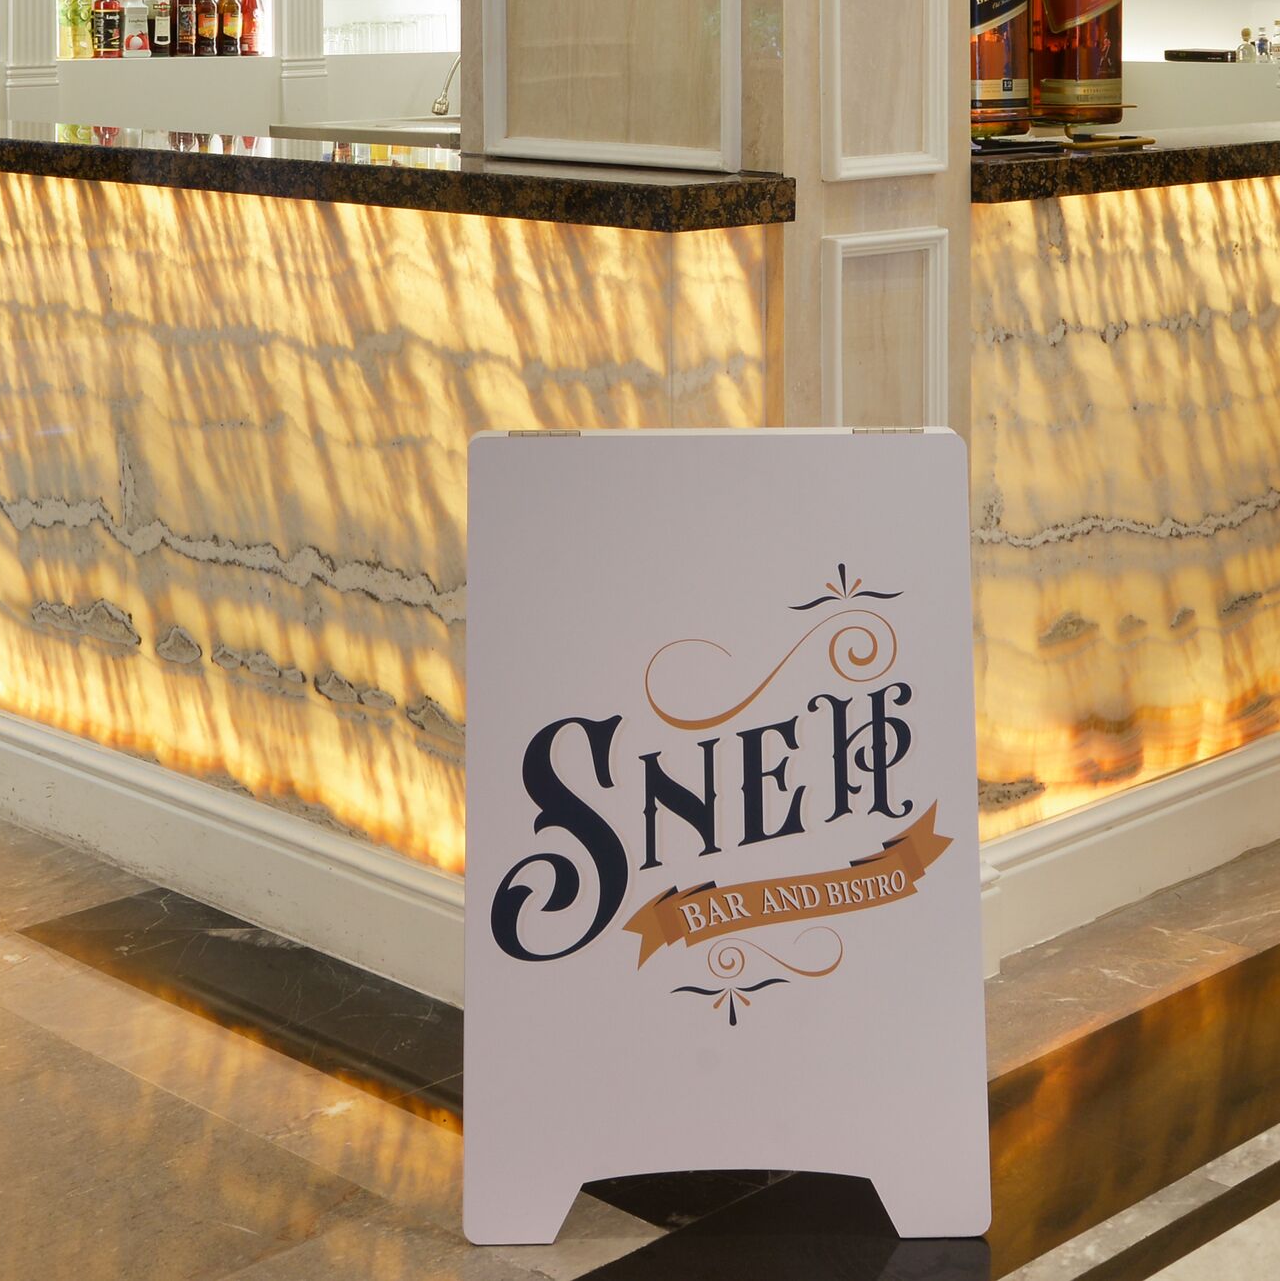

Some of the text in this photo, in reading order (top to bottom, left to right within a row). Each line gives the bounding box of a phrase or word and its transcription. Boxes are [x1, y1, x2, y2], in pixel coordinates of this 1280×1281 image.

[1003, 79, 1013, 88] 12
[489, 681, 915, 962] SNEH
[678, 868, 908, 936] BAR AND BISTRO
